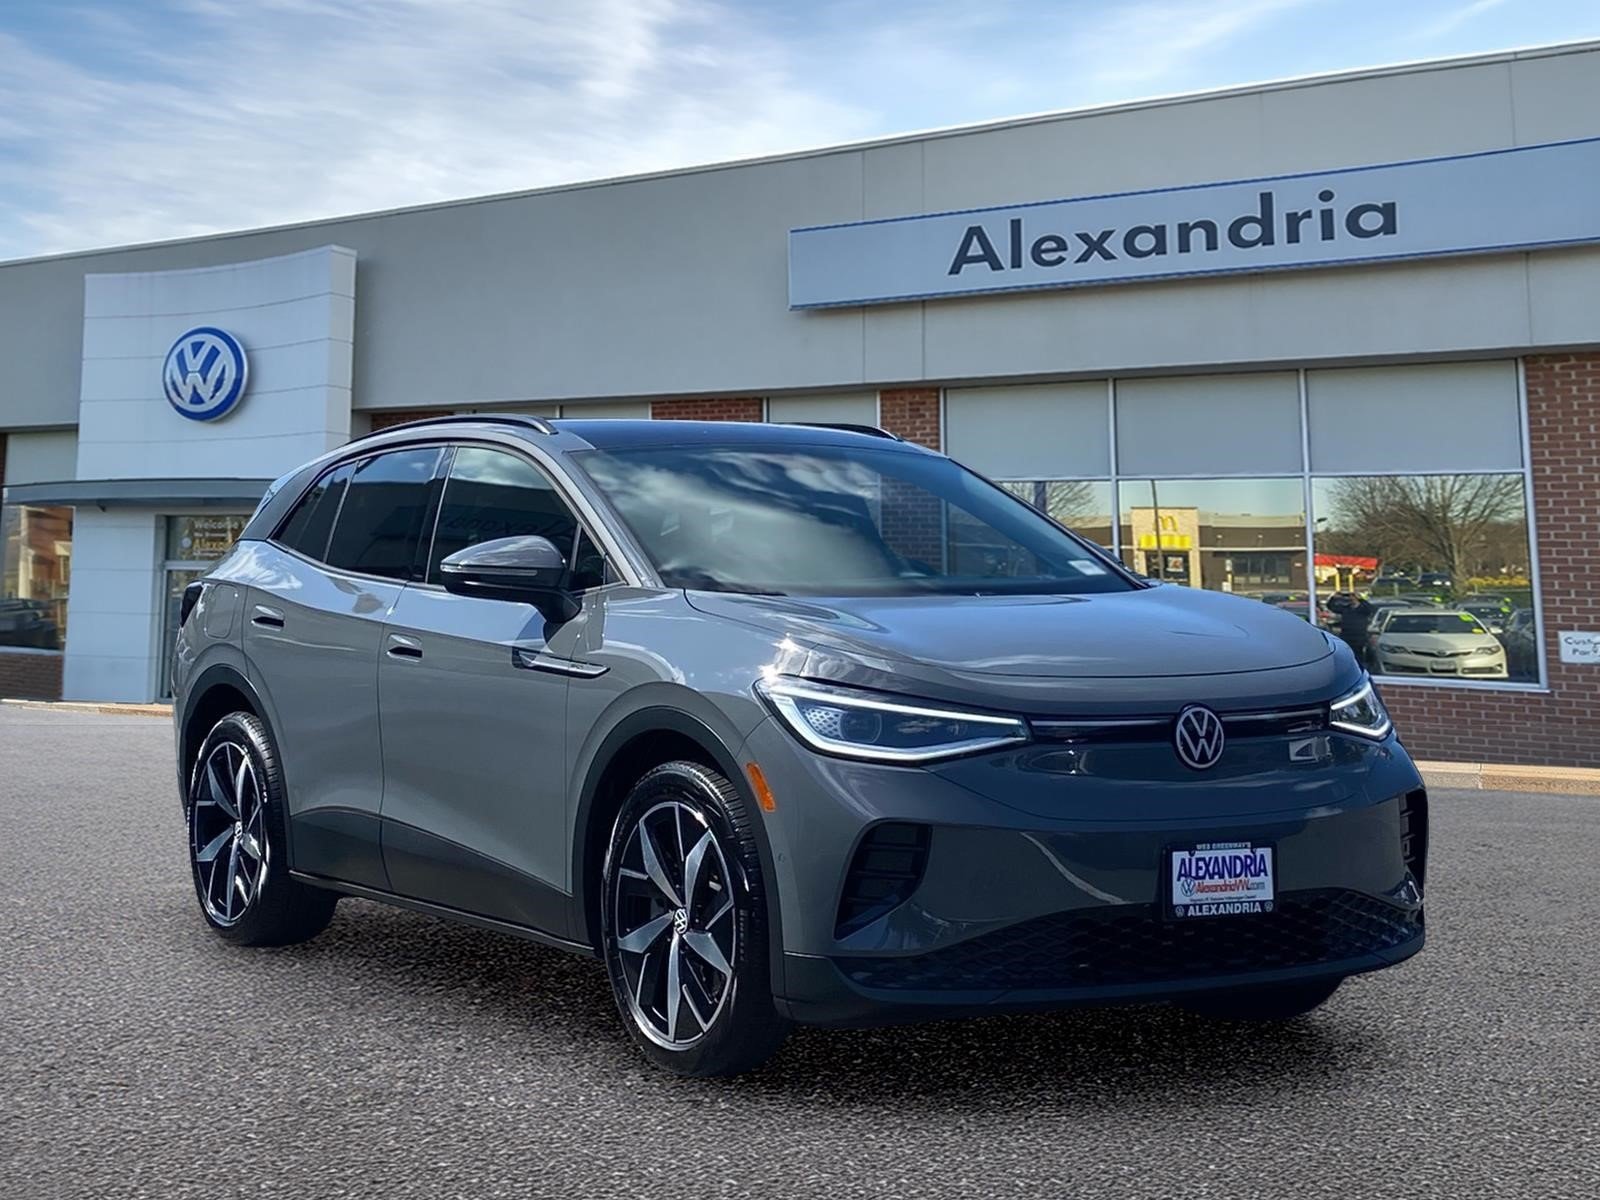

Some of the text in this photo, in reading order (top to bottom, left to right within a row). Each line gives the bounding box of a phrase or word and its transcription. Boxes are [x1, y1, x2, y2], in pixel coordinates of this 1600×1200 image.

[947, 189, 1398, 276] Alexandria
[1177, 852, 1269, 881] ALEXANDRIA
[1187, 901, 1262, 917] ALEXANDRIA
